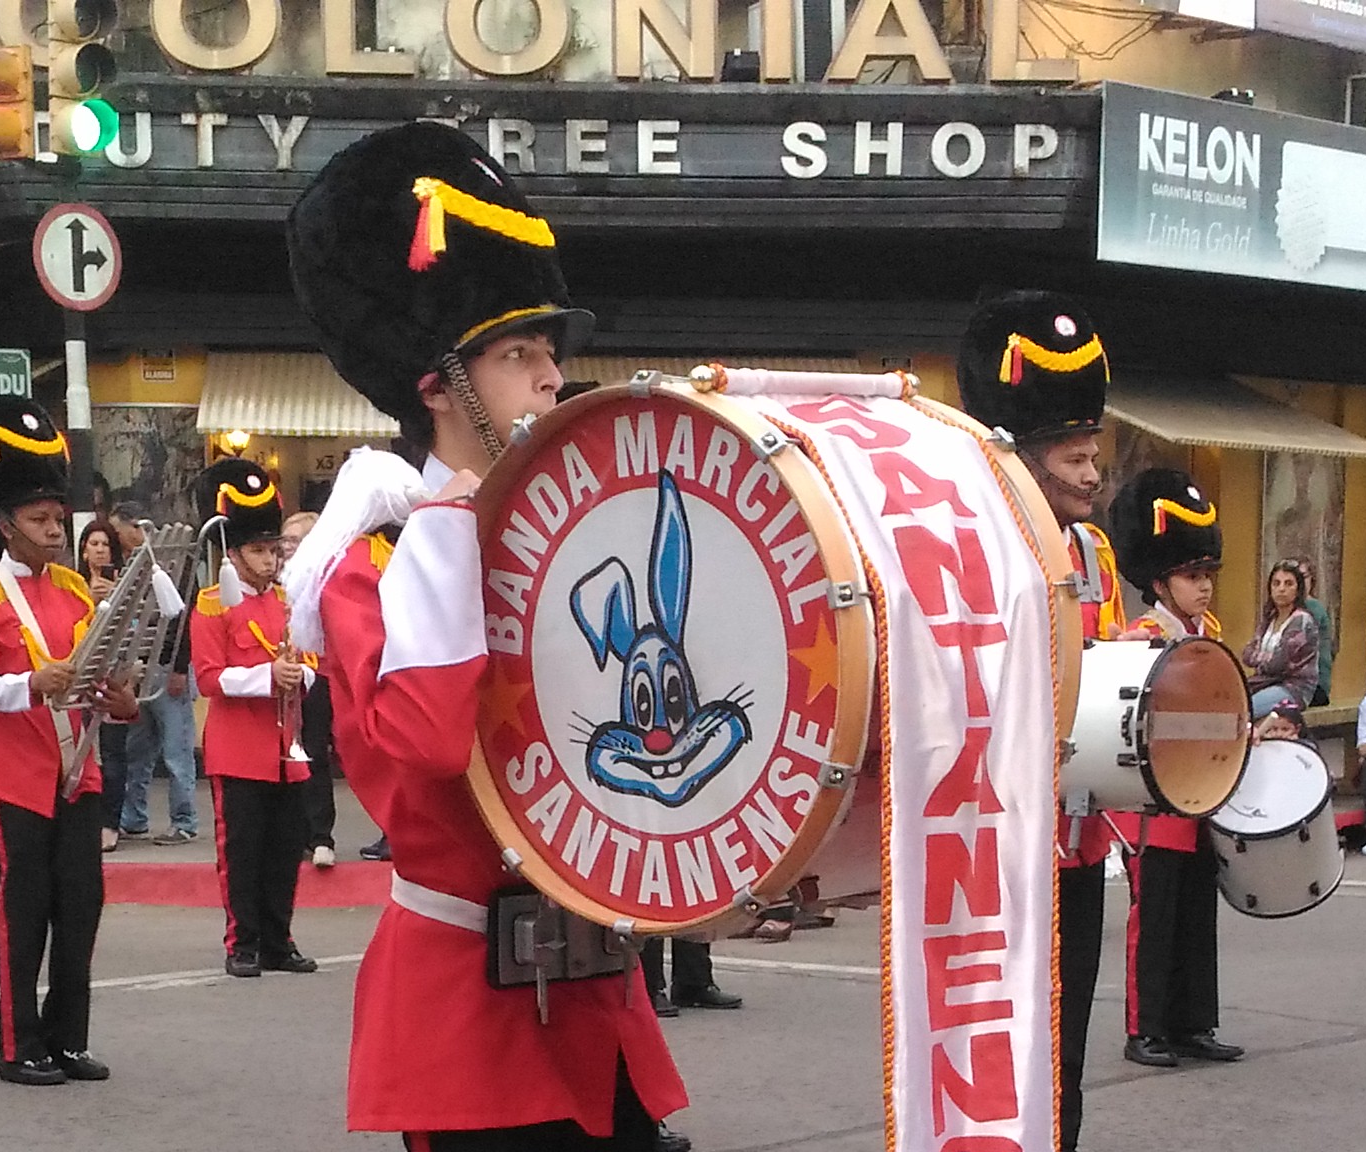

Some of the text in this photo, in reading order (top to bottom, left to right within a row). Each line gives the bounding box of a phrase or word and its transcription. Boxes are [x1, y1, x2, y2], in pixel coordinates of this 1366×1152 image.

[416, 116, 682, 174] REE
[780, 121, 1059, 178] SHOP
[1138, 112, 1261, 189] KELON
[1152, 182, 1191, 201] GARANTIA
[1146, 212, 1252, 257] Linha Gold
[485, 410, 834, 656] BANDA MARCIAL
[505, 711, 834, 907] SANTANENSE
